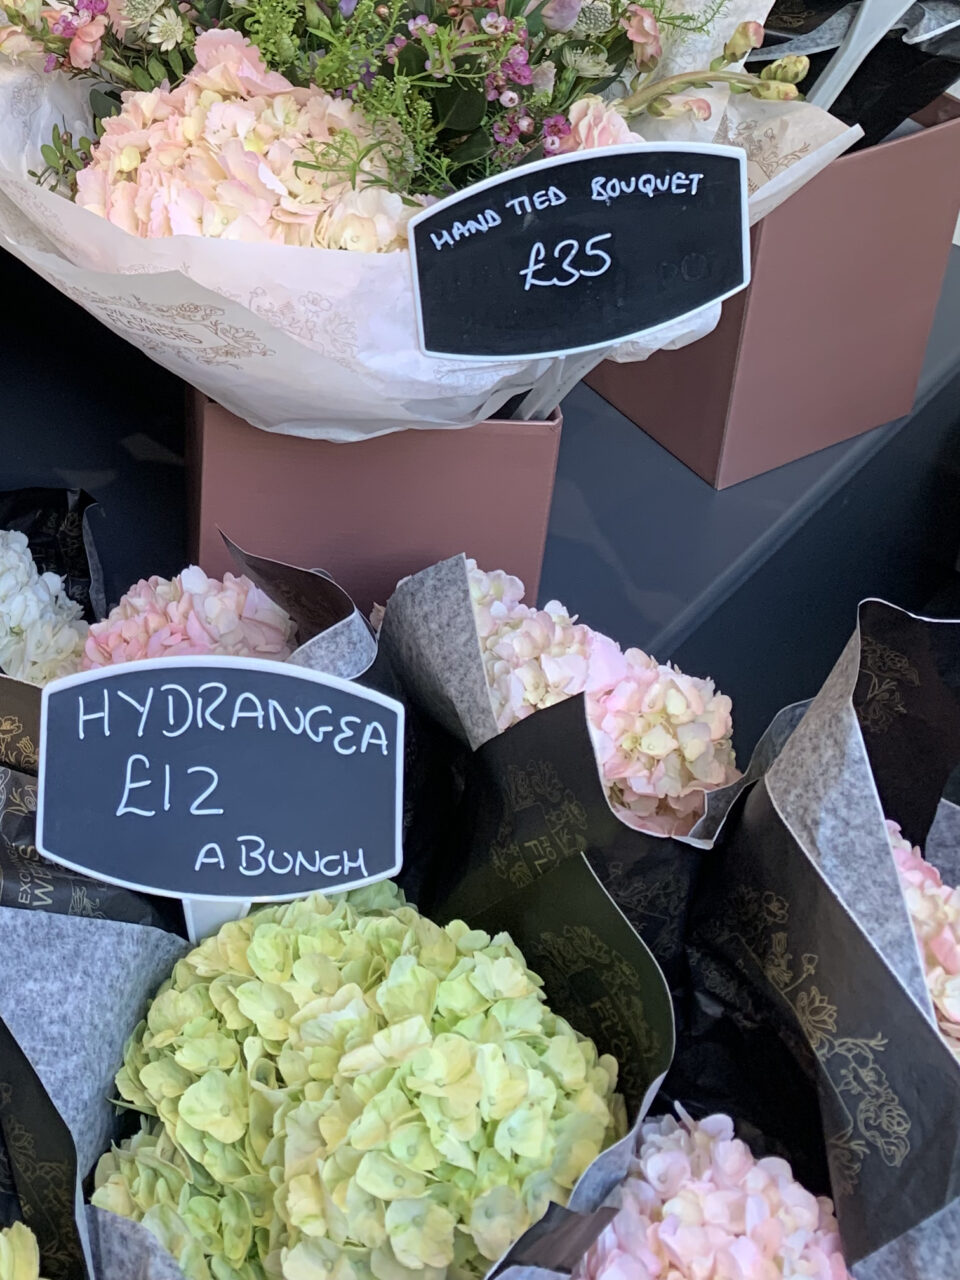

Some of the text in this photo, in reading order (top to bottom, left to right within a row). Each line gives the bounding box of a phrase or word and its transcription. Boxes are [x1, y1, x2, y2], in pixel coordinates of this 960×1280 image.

[430, 172, 704, 251] HAND TIED BOUQUET
[519, 232, 613, 291] £35
[78, 681, 389, 756] HYDRANGEA
[115, 753, 225, 817] £12
[19, 844, 55, 907] WERS
[194, 834, 369, 878] A BUNCH
